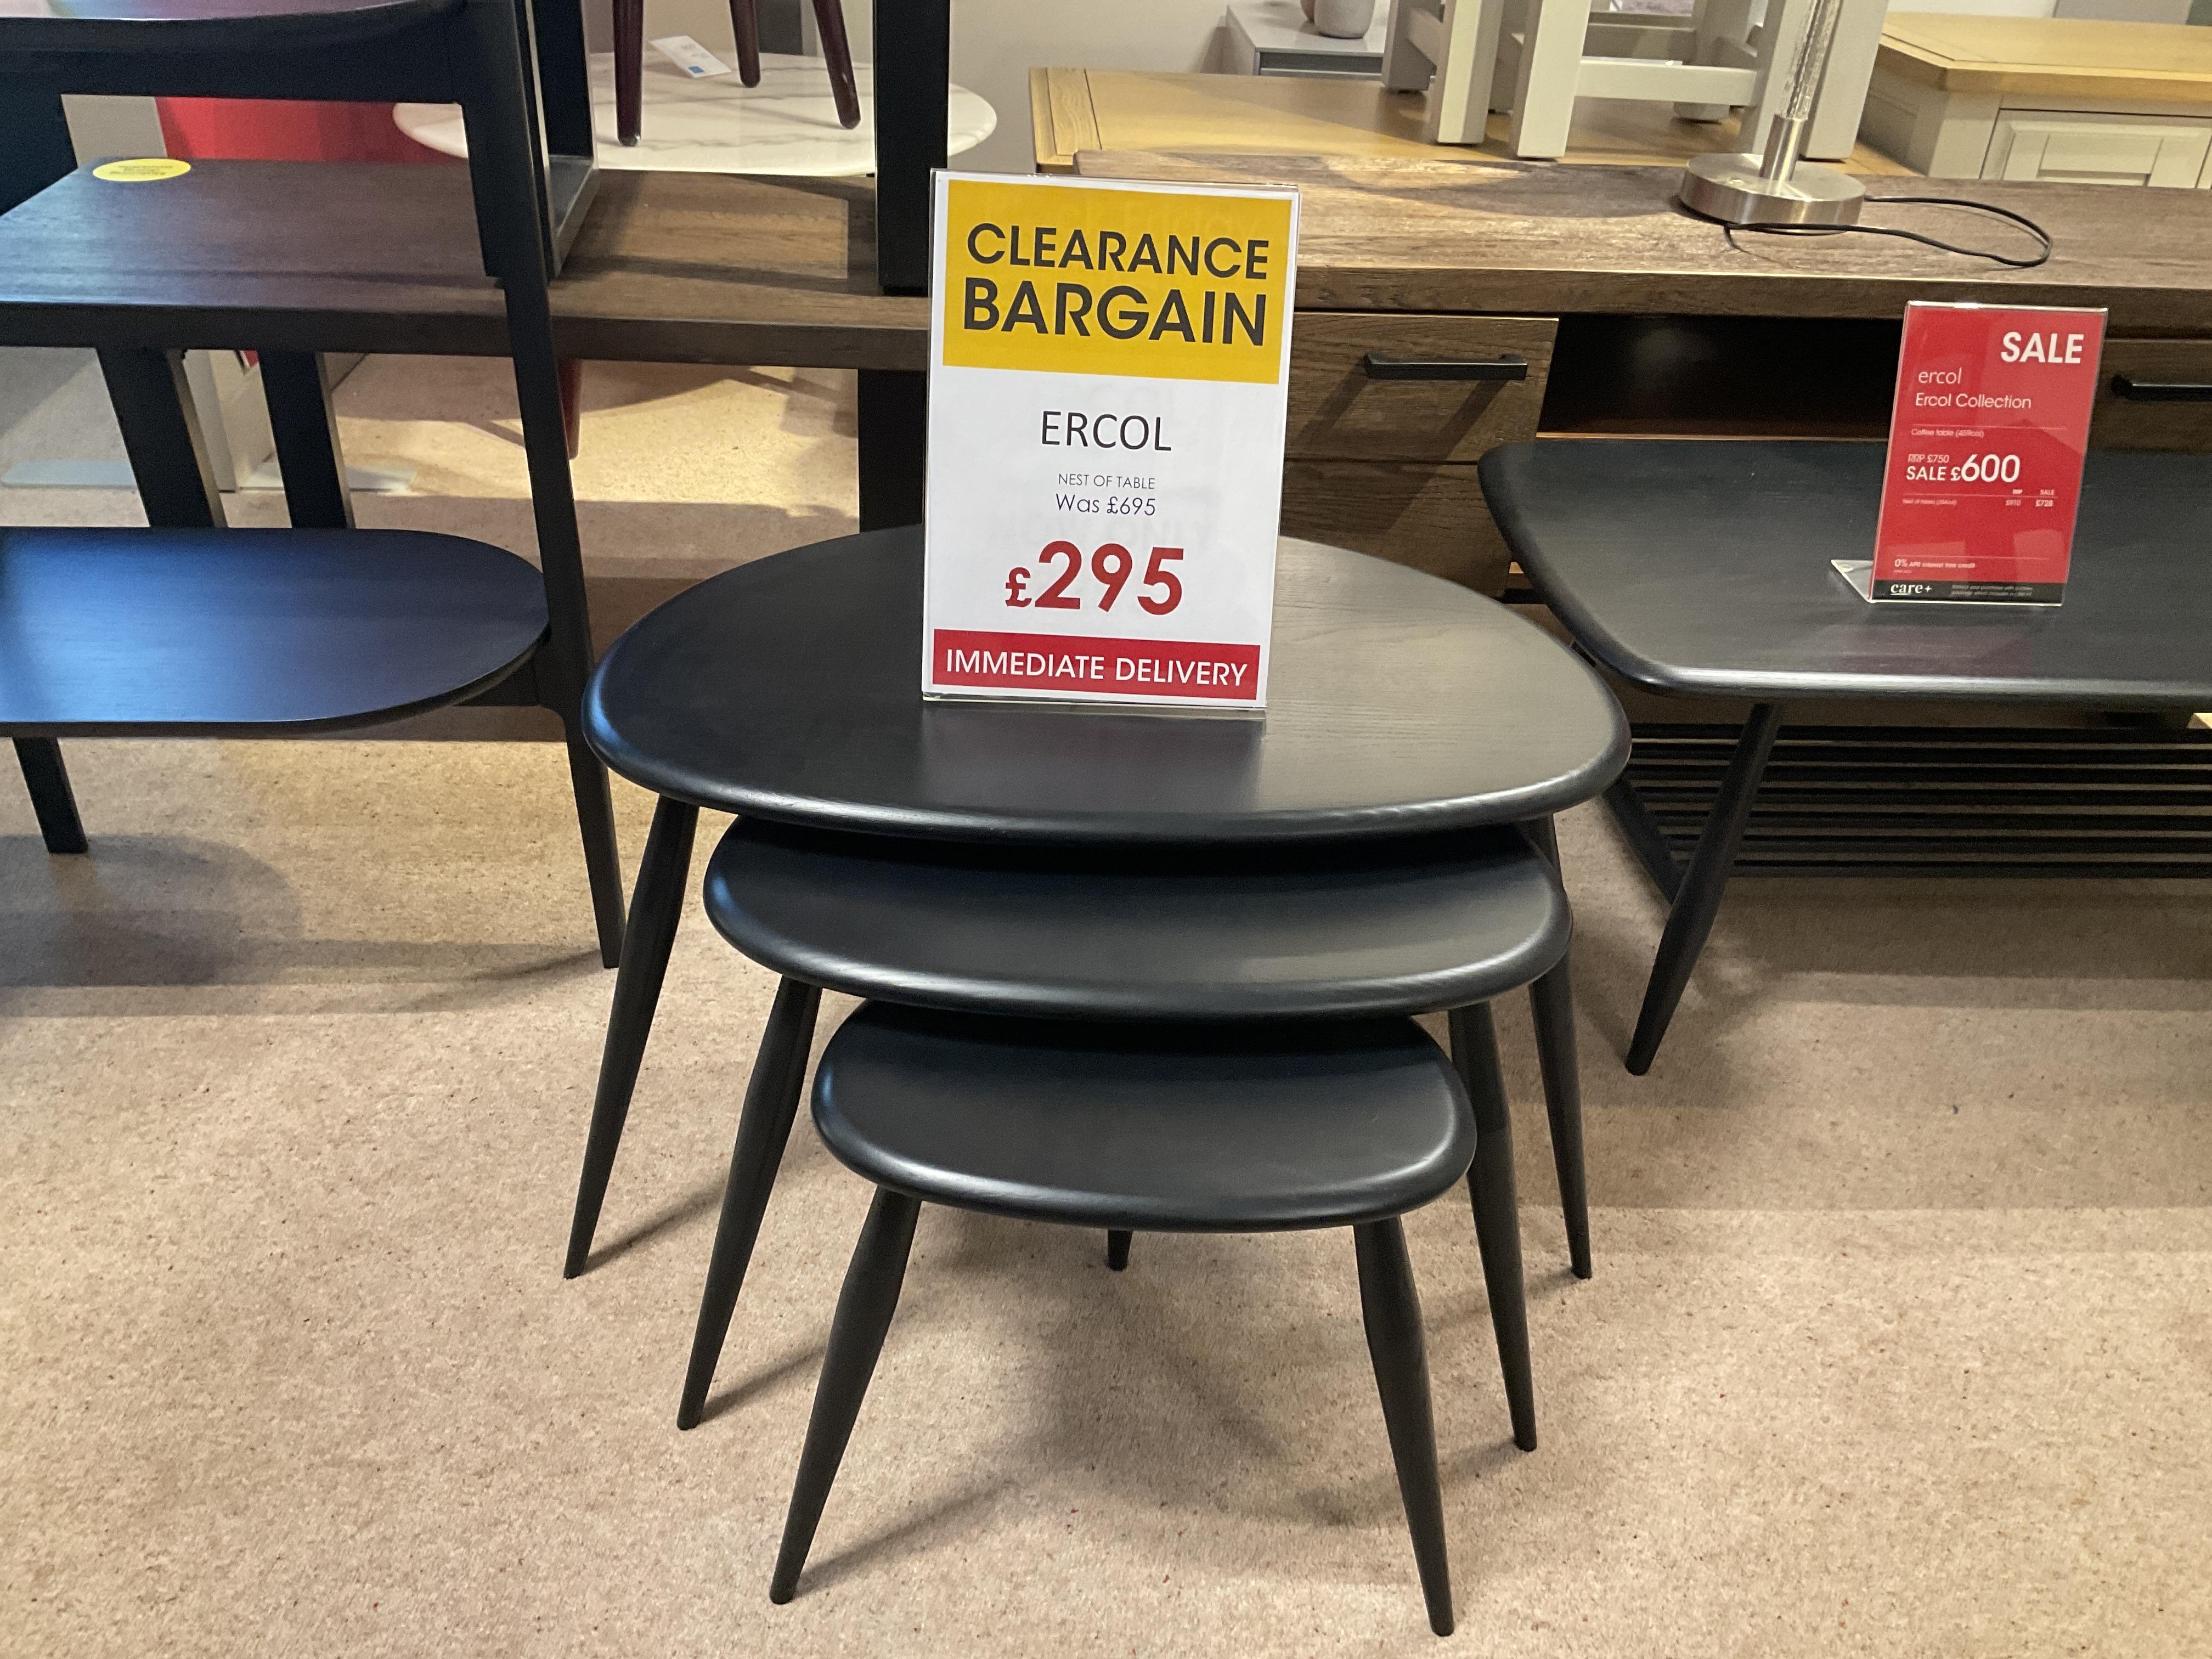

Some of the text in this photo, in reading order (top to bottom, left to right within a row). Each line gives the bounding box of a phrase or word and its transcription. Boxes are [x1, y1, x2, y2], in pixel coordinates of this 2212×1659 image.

[966, 223, 1268, 280] CLEARANCE
[964, 277, 1266, 346] BARGAIN
[2001, 331, 2084, 364] SALE
[1918, 367, 1962, 384] ercol
[1915, 392, 2032, 409] Ercol Collection
[1042, 411, 1171, 451] ERCOL
[1906, 454, 2021, 483] SALE £600
[1908, 454, 1950, 464] RRP £750
[1058, 473, 1155, 489] NEST OF TABLE
[1056, 493, 1155, 516] Was £695
[1894, 558, 1908, 567] 0%
[1005, 540, 1184, 616] £295
[947, 649, 1248, 686] IMMEDIATE DELIVERY
